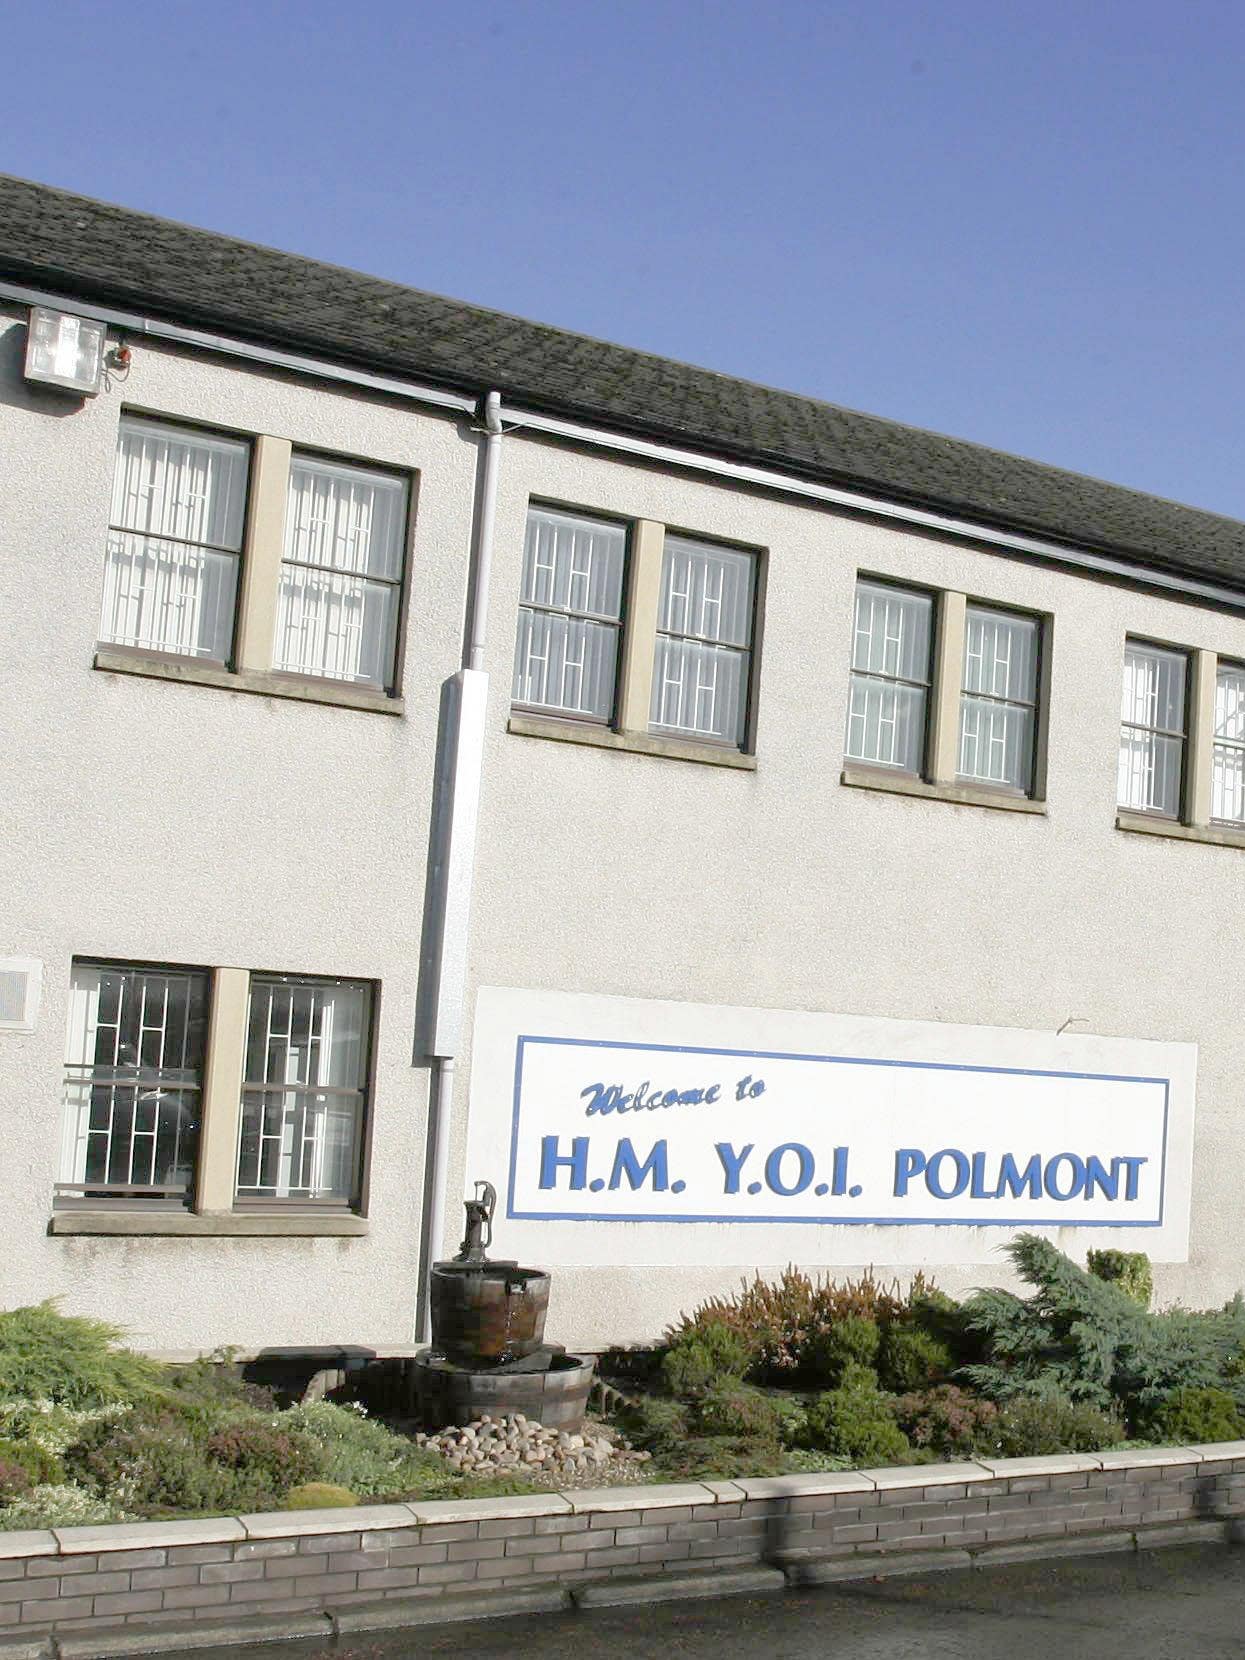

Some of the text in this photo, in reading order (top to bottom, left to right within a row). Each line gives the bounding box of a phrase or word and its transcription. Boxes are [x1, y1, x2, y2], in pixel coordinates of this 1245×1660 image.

[579, 1074, 767, 1118] Welcome to
[537, 1134, 1149, 1202] H.M. Y.O.I. POLMONT
